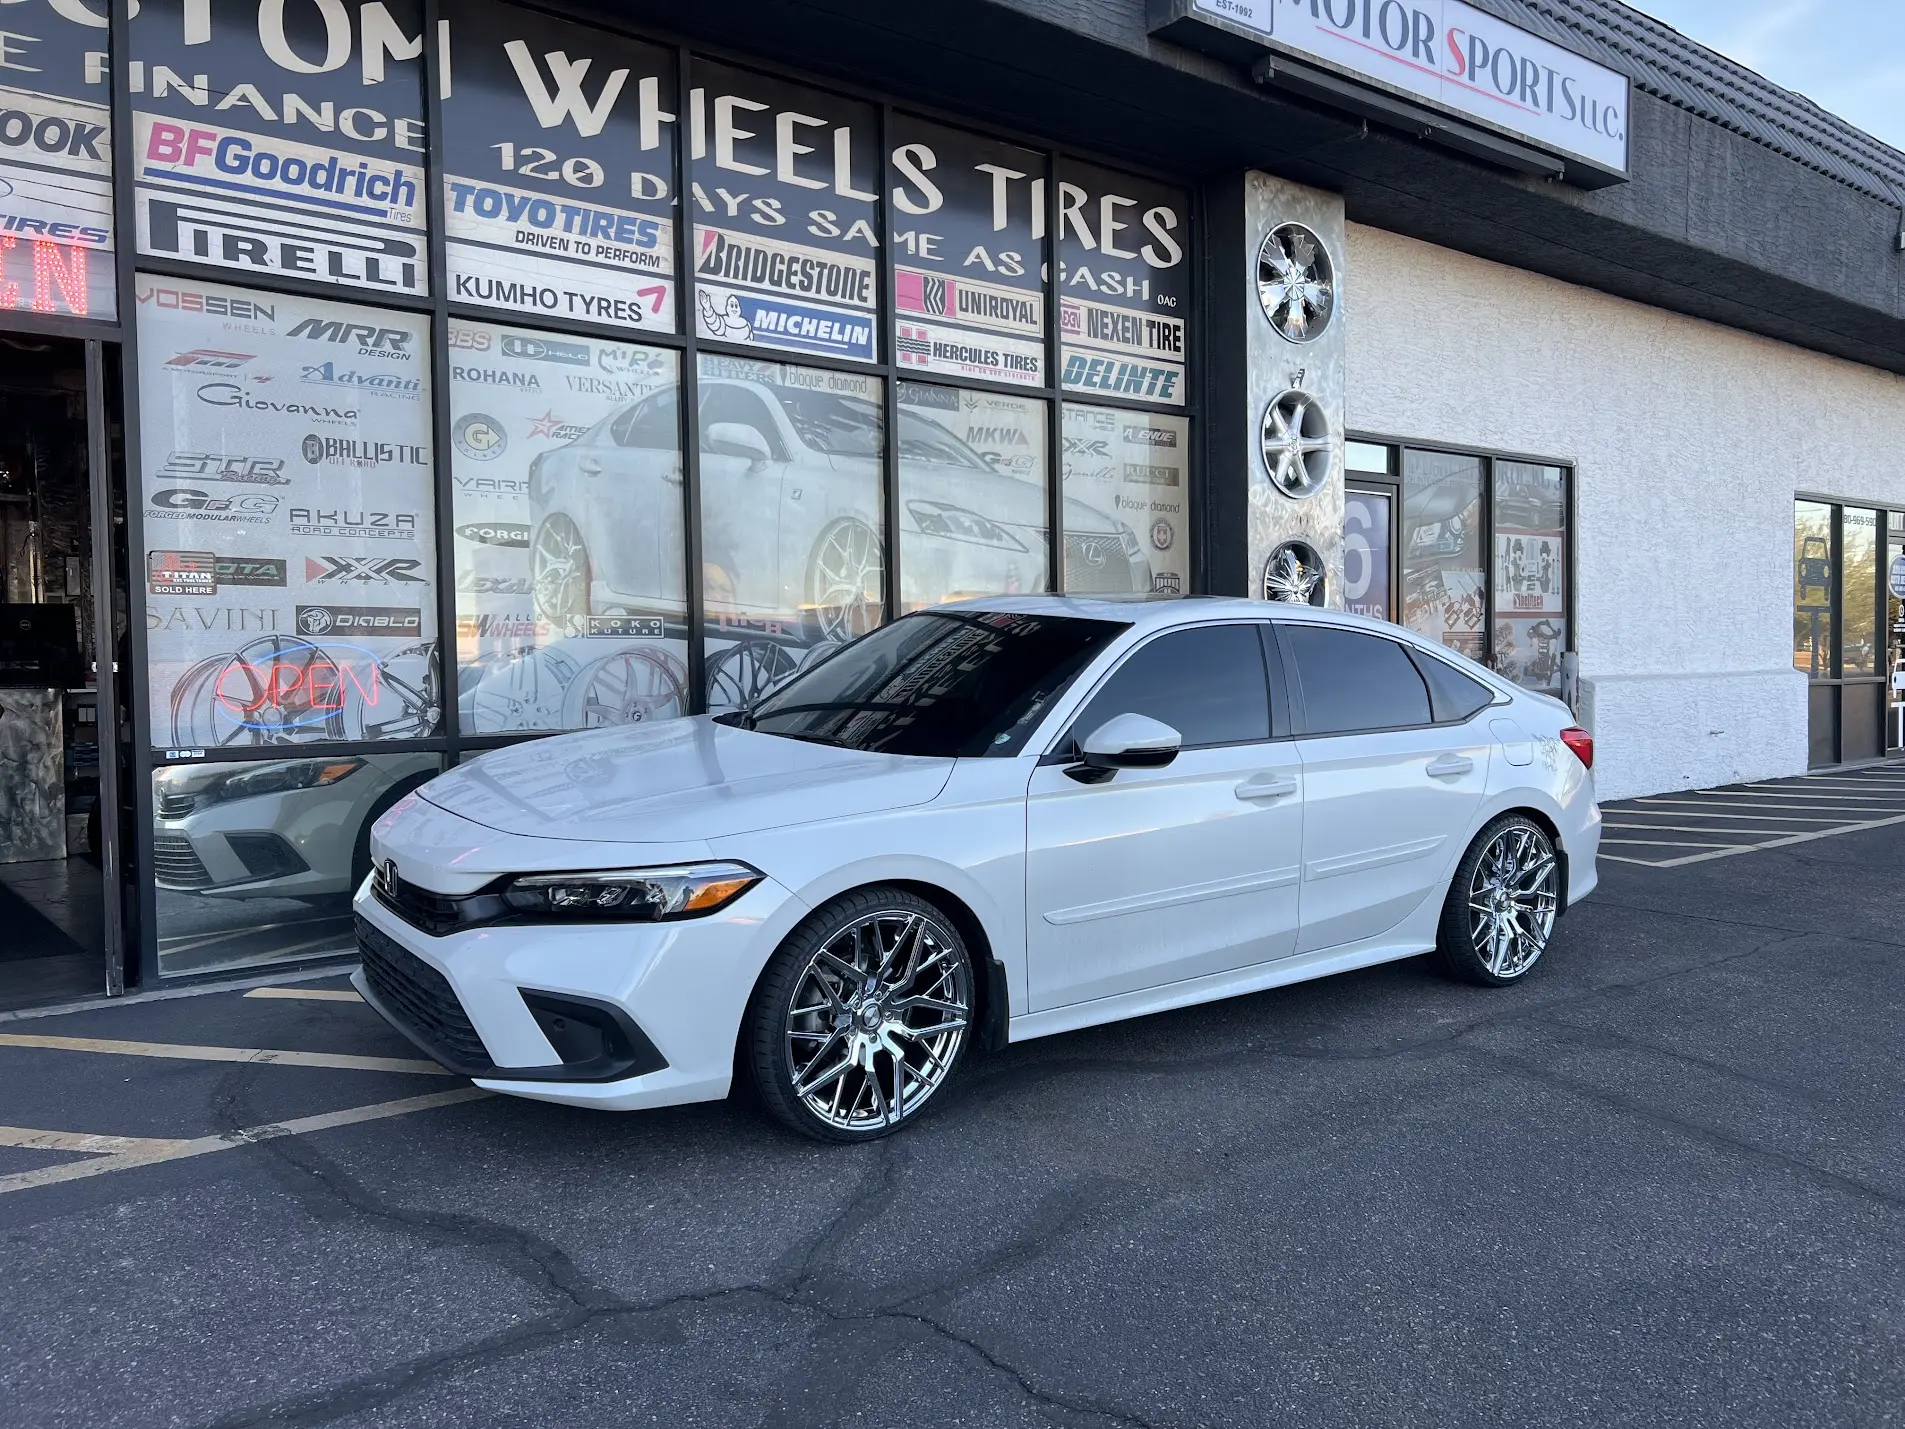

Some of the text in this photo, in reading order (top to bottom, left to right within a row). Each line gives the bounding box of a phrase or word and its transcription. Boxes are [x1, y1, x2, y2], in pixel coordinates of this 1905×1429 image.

[1215, 0, 1253, 18] EST-1992
[1446, 27, 1577, 120] SPORTS
[146, 121, 416, 207] BFGoodrich
[503, 40, 944, 215] WHEELS
[974, 163, 1183, 269] TIRES
[84, 51, 426, 153] FINANCE
[490, 142, 604, 188] 120
[631, 172, 786, 226] DAYS
[807, 210, 944, 261] SAME
[963, 246, 1025, 276] AS
[1040, 260, 1150, 301] CASH
[0, 213, 109, 243] IRES
[388, 207, 412, 224] Tires
[149, 199, 417, 289] PIRELLI
[515, 230, 660, 268] DRIVEN TO PERFORM
[698, 231, 872, 302] BRIDGESTONE
[135, 287, 275, 322] VOSSEN
[456, 274, 643, 323] KUMHO TYRES
[958, 289, 1038, 325] UNIROYAL
[285, 318, 413, 351] MRR
[754, 308, 869, 345] MICHELIN
[1087, 308, 1181, 353] NEXEN TIRE
[358, 347, 411, 361] DESIGN
[933, 341, 1038, 373] HERCULES TIRES
[301, 362, 421, 391] Advanti
[453, 366, 541, 388] ROHANA
[789, 366, 867, 394] blaque diamond
[1063, 355, 1179, 399] DELINTE
[196, 383, 359, 420] Giovanna
[370, 390, 420, 402] RACING
[324, 436, 428, 466] BALLISTIC
[965, 426, 1018, 446] MKW
[1126, 465, 1169, 478] RUCCI
[290, 508, 416, 529] AKUZA
[292, 526, 415, 538] ROAD CONCEPTS
[216, 563, 278, 575] OTA
[185, 586, 212, 594] HERE
[591, 619, 661, 629] KOKO
[217, 662, 379, 712] OPEN
